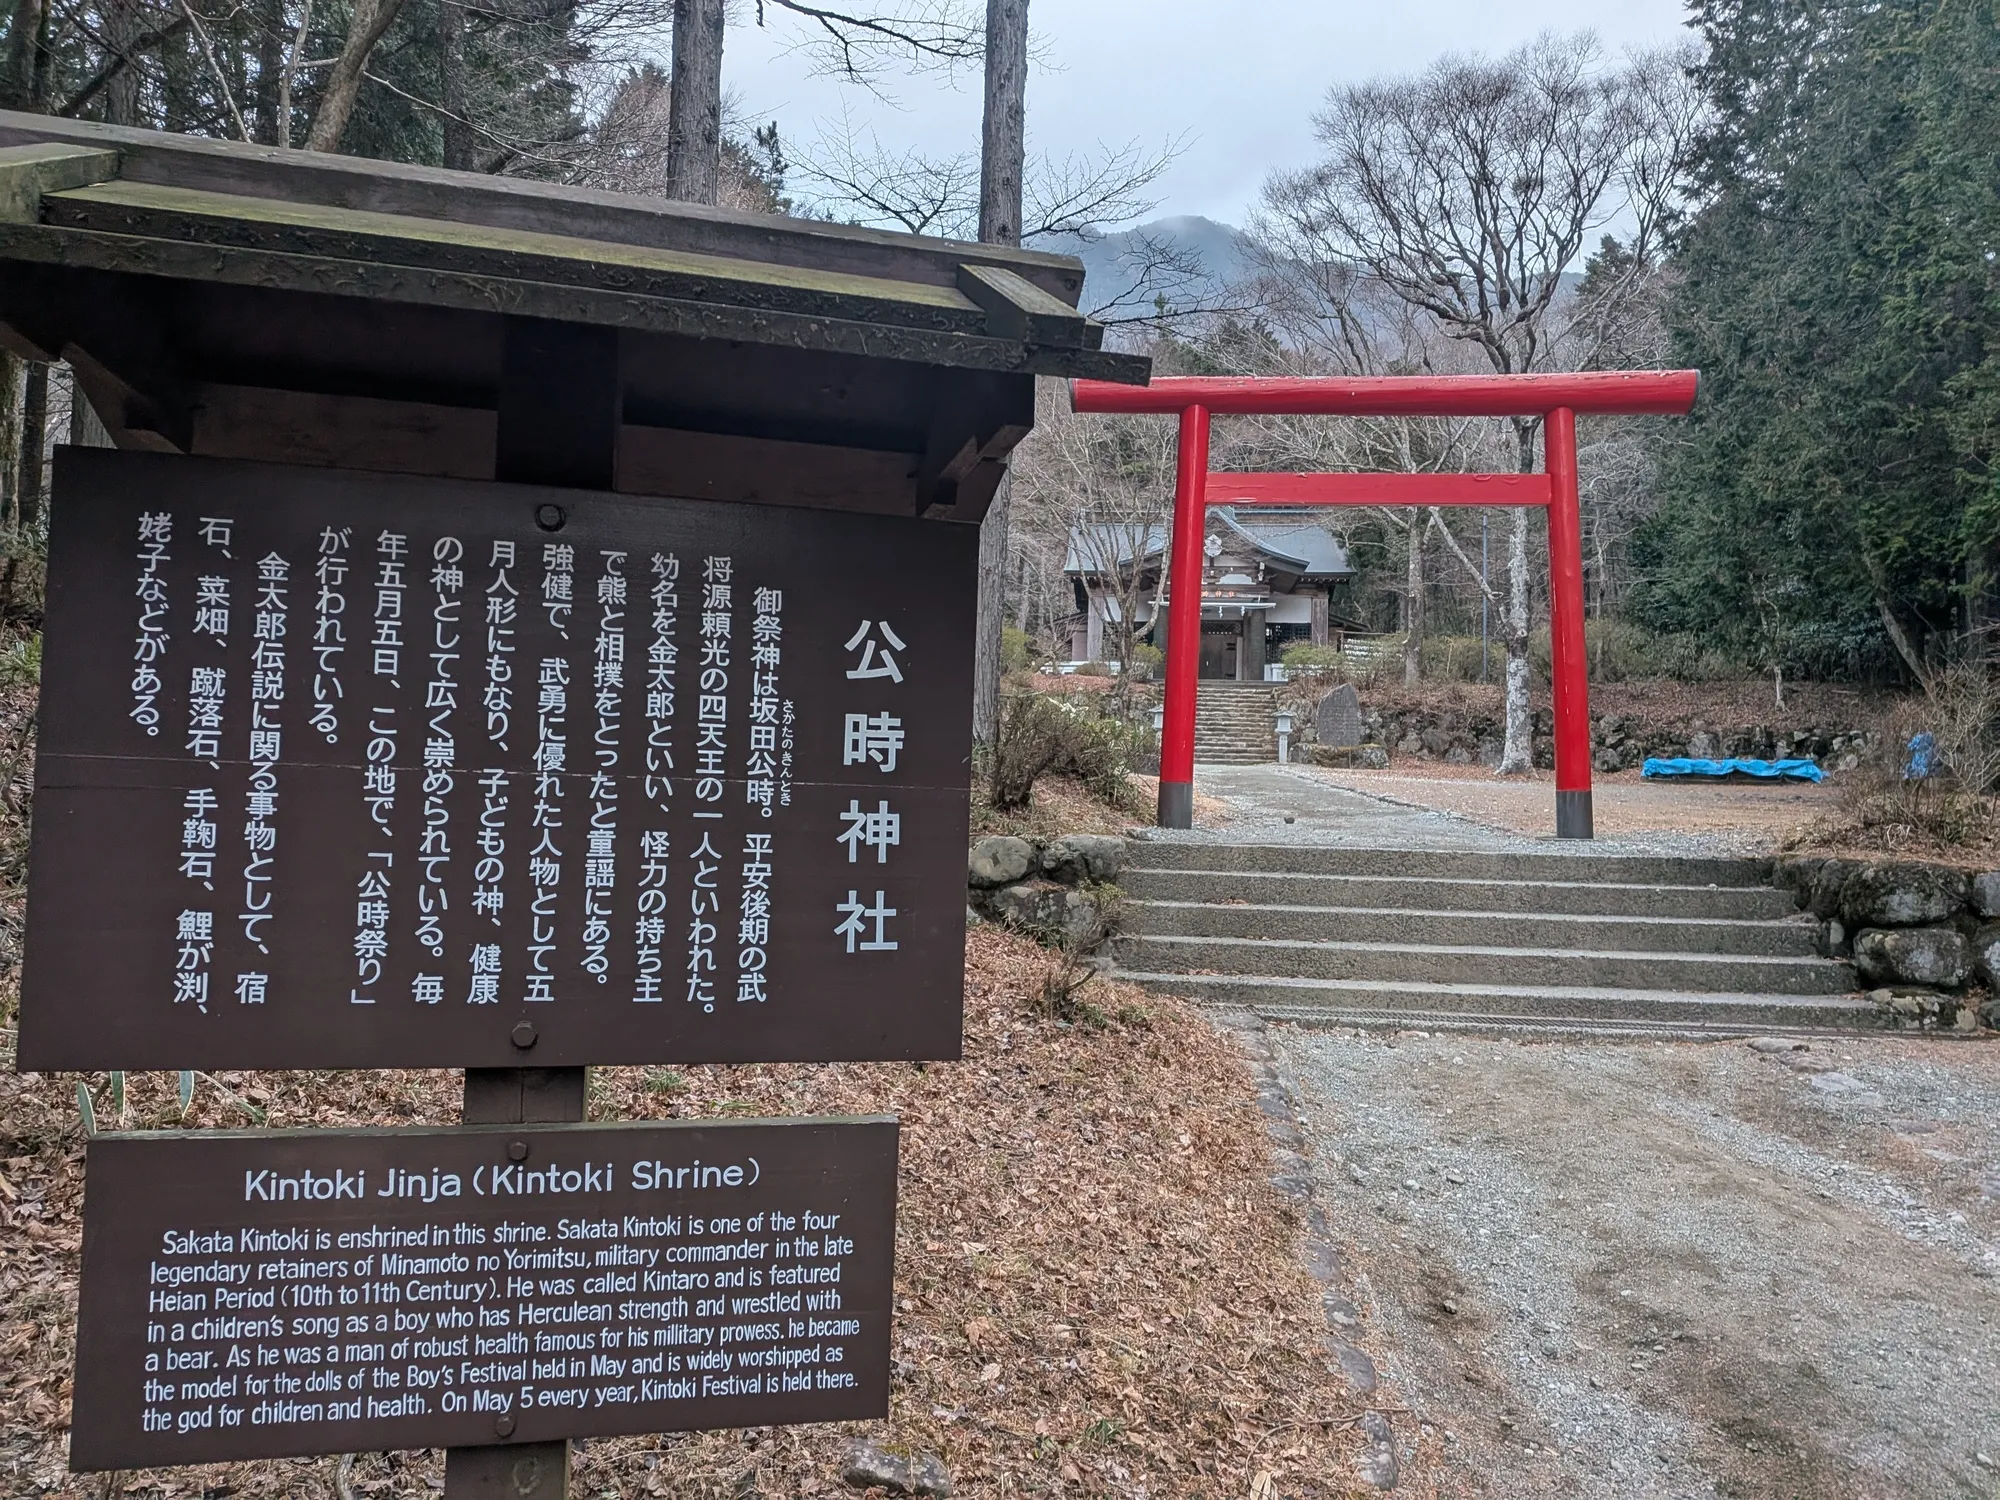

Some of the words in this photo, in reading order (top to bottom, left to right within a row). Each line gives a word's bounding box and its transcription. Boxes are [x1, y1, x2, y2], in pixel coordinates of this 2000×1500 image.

[128, 511, 173, 737] 姥子などがある。
[308, 525, 353, 744] が行われている。
[779, 699, 796, 806] さかたのきんとき
[833, 619, 907, 954] 公時神社
[245, 1168, 365, 1202] Kintoki
[377, 1166, 461, 1203] Jinja
[472, 1161, 613, 1196] (Kintoki
[631, 1157, 760, 1190] Shrine)
[150, 1259, 252, 1288] legendary
[257, 1257, 349, 1281] retainers
[353, 1254, 375, 1277] of
[381, 1251, 470, 1276] Minamoto
[476, 1255, 501, 1272] no
[503, 1246, 592, 1271] Yorimitsu,
[594, 1243, 660, 1268] military
[665, 1238, 770, 1263] commander
[775, 1237, 790, 1259] in
[792, 1234, 819, 1258] the
[823, 1234, 854, 1257] late
[161, 1229, 234, 1255] Sakata
[240, 1227, 309, 1253] Kintoki
[315, 1227, 332, 1251] is
[337, 1223, 429, 1249] enshrined
[432, 1224, 450, 1247] in
[452, 1221, 486, 1245] this
[492, 1220, 552, 1244] shrine.
[556, 1218, 619, 1240] Sakata
[623, 1214, 682, 1238] Kintoki
[688, 1214, 704, 1236] is
[709, 1217, 741, 1235] one
[746, 1211, 765, 1233] of
[769, 1210, 797, 1232] the
[801, 1210, 841, 1231] four
[147, 1320, 166, 1343] in
[170, 1322, 185, 1342] a
[190, 1314, 284, 1341] children's
[291, 1316, 340, 1339] song
[345, 1315, 370, 1333] as
[374, 1314, 388, 1332] a
[393, 1307, 431, 1334] boy
[435, 1305, 474, 1329] who
[478, 1304, 511, 1328] has
[518, 1300, 613, 1326] Herculean
[617, 1295, 689, 1322] strength
[695, 1293, 725, 1317] and
[731, 1289, 801, 1316] wrestled
[805, 1287, 841, 1312] with
[148, 1290, 207, 1313] Heian
[214, 1285, 275, 1310] Period
[280, 1283, 333, 1308] (10th
[336, 1284, 359, 1305] to
[361, 1281, 401, 1305] 11th
[405, 1276, 502, 1303] Century).
[506, 1275, 535, 1299] He
[538, 1278, 576, 1296] was
[582, 1270, 637, 1294] called
[642, 1269, 710, 1293] Kintaro
[714, 1266, 745, 1288] and
[748, 1266, 763, 1287] is
[768, 1261, 841, 1286] featured
[142, 1377, 176, 1403] the
[181, 1374, 238, 1401] model
[243, 1373, 271, 1396] for
[272, 1371, 302, 1394] the
[304, 1369, 343, 1393] dolls
[347, 1367, 366, 1390] of
[371, 1366, 401, 1389] the
[406, 1364, 454, 1389] Boy's
[460, 1359, 527, 1385] Festival
[532, 1357, 566, 1381] held
[570, 1356, 586, 1378] in
[590, 1354, 627, 1379] May
[631, 1351, 663, 1375] and
[667, 1351, 682, 1372] is
[685, 1348, 734, 1373] widely
[737, 1343, 821, 1370] worshipped
[825, 1346, 844, 1363] as
[144, 1352, 159, 1372] a
[166, 1347, 219, 1371] bear.
[225, 1344, 252, 1368] As
[257, 1343, 280, 1367] he
[283, 1346, 322, 1365] was
[326, 1344, 339, 1363] a
[344, 1343, 385, 1363] man
[390, 1336, 410, 1360] of
[413, 1334, 470, 1359] robust
[474, 1331, 529, 1356] health
[533, 1330, 596, 1353] famous
[599, 1326, 624, 1349] for
[627, 1325, 650, 1348] his
[653, 1323, 715, 1347] millitary
[719, 1322, 785, 1347] prowess.
[788, 1317, 805, 1339] he
[808, 1316, 860, 1339] became
[141, 1407, 172, 1432] the
[177, 1404, 213, 1435] god
[217, 1403, 246, 1428] for
[251, 1399, 324, 1425] children
[326, 1395, 362, 1421] and
[366, 1392, 433, 1419] health.
[441, 1390, 467, 1413] On
[472, 1388, 514, 1414] May
[519, 1385, 534, 1409] 5
[537, 1387, 590, 1409] every
[594, 1384, 639, 1408] year,
[641, 1376, 697, 1402] Kintoki
[702, 1372, 762, 1398] Festival
[766, 1372, 779, 1394] is
[782, 1369, 812, 1393] held
[815, 1368, 859, 1390] there.
